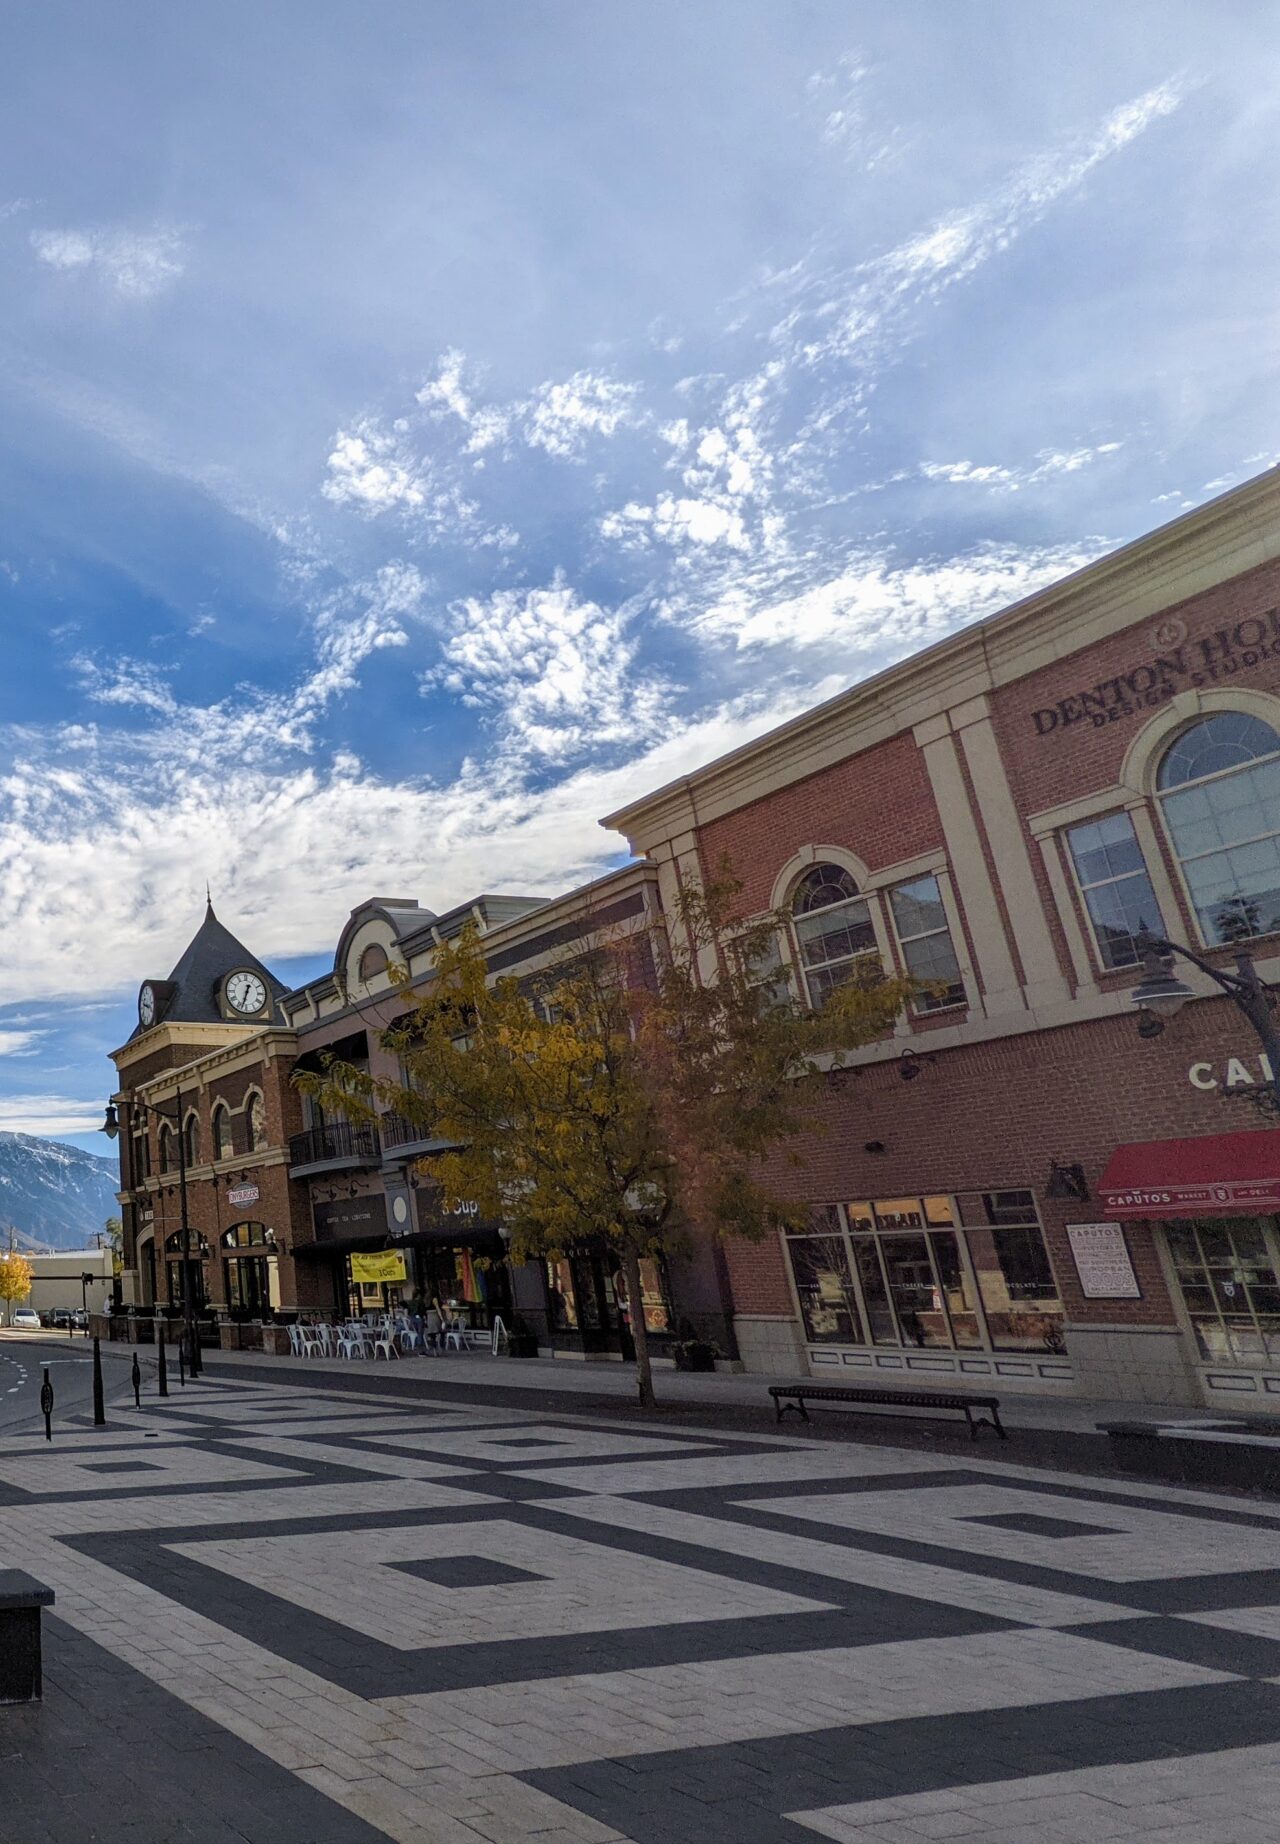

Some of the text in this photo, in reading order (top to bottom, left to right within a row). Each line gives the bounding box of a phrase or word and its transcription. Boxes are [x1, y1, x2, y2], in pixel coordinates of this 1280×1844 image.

[1031, 606, 1280, 735] DENTON HO
[1092, 683, 1176, 728] DESIGN
[453, 1197, 479, 1218] Cup
